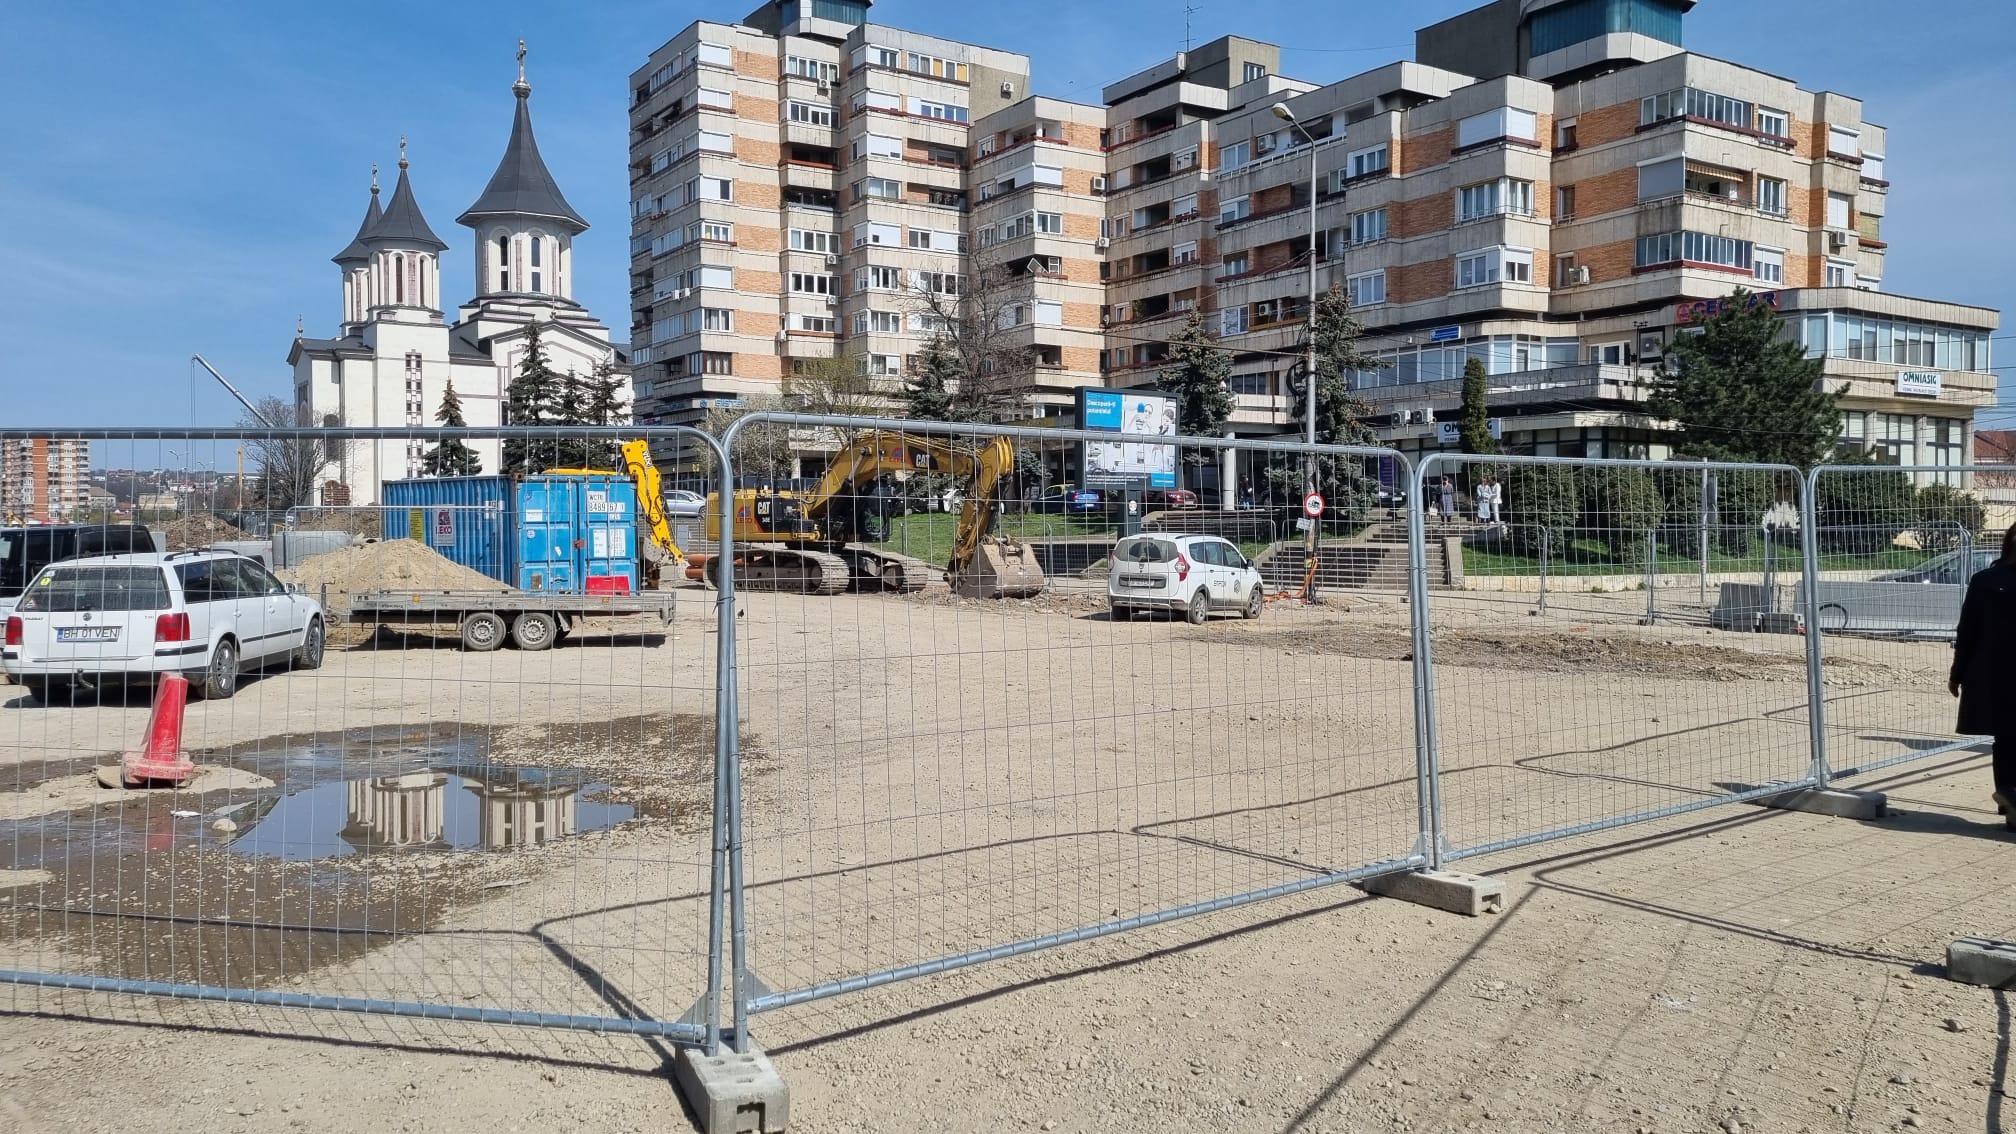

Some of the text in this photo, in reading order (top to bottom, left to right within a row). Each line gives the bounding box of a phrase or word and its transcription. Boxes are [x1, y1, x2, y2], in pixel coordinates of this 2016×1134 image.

[1694, 291, 1777, 314] CECAR
[1903, 372, 1937, 384] OMNIASIG
[916, 454, 930, 468] CAT
[757, 501, 771, 515] CAT
[63, 628, 118, 639] BH 01 VEN
